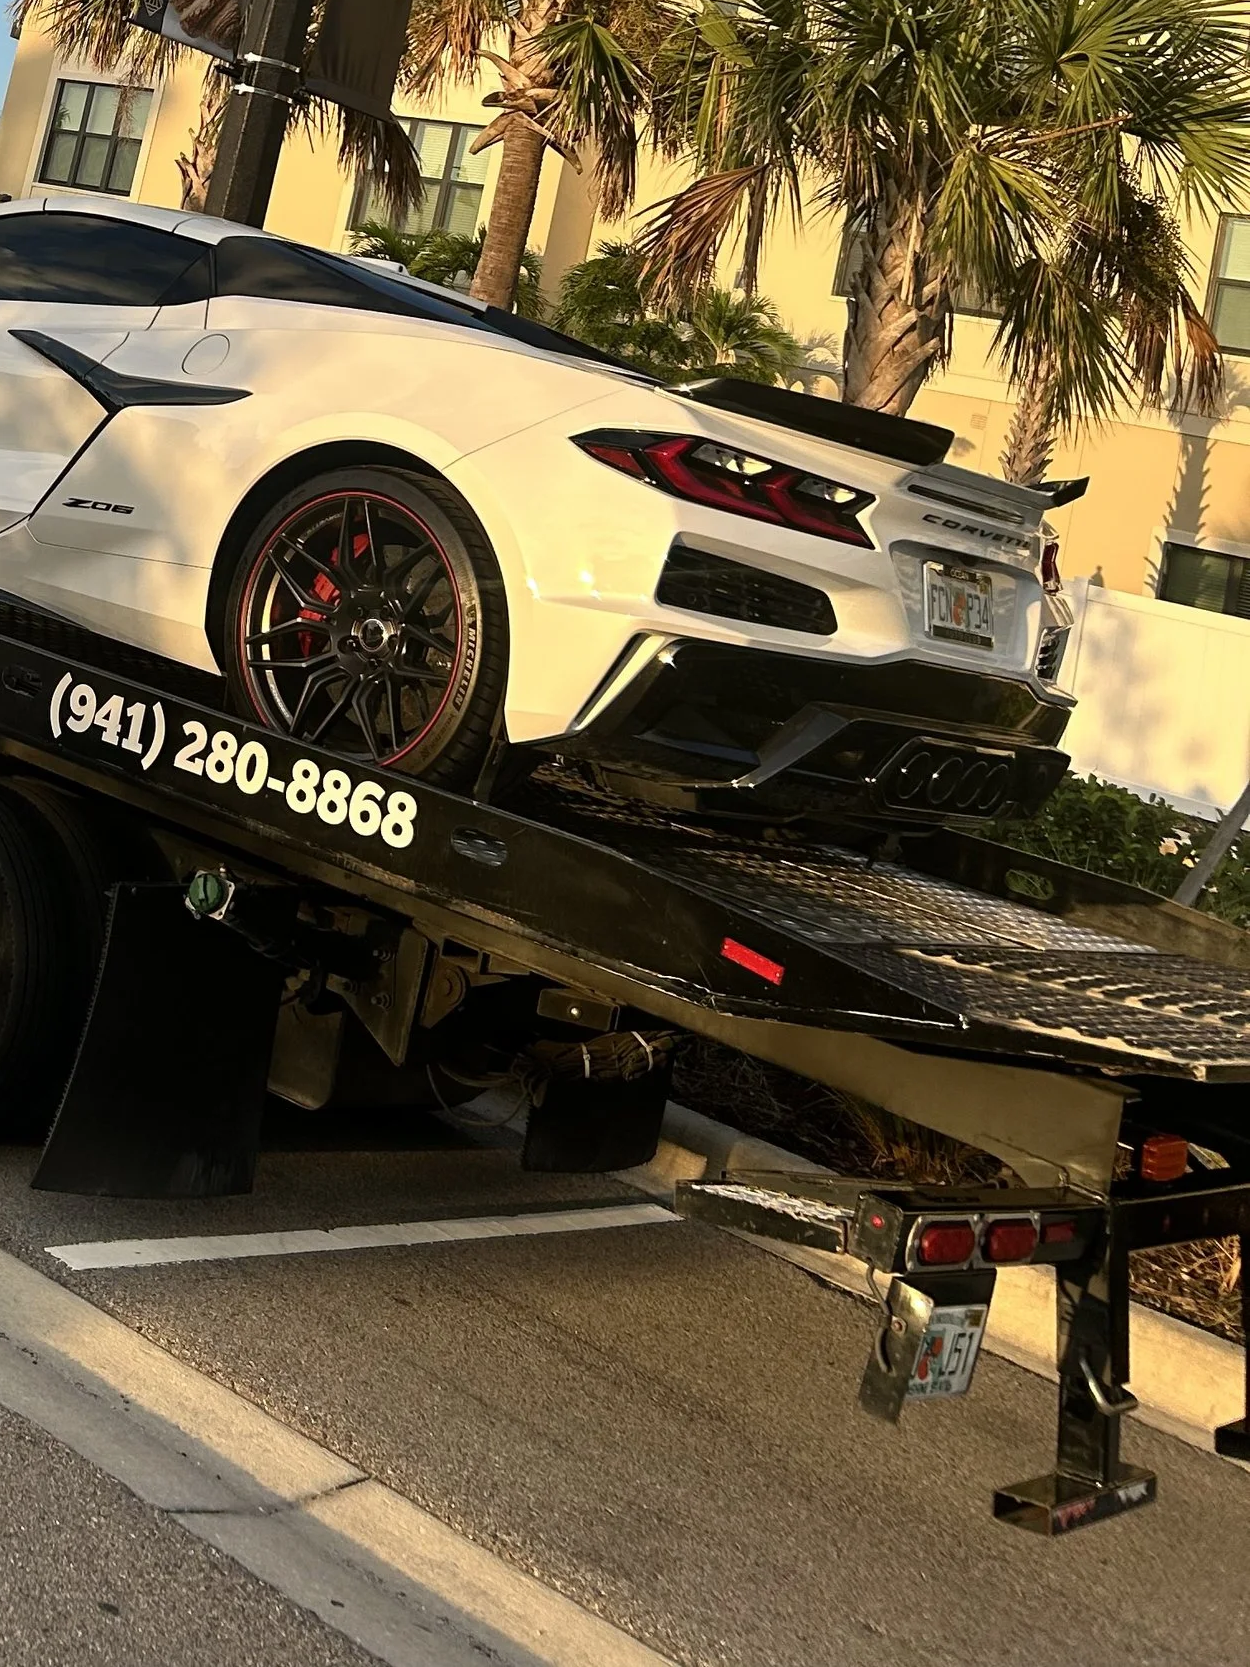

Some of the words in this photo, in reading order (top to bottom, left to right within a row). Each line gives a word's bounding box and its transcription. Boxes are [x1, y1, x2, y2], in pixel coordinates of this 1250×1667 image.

[61, 497, 135, 515] Z06
[455, 627, 477, 708] MICHELIN
[50, 671, 166, 771] (941)
[173, 720, 418, 849] 280-8868
